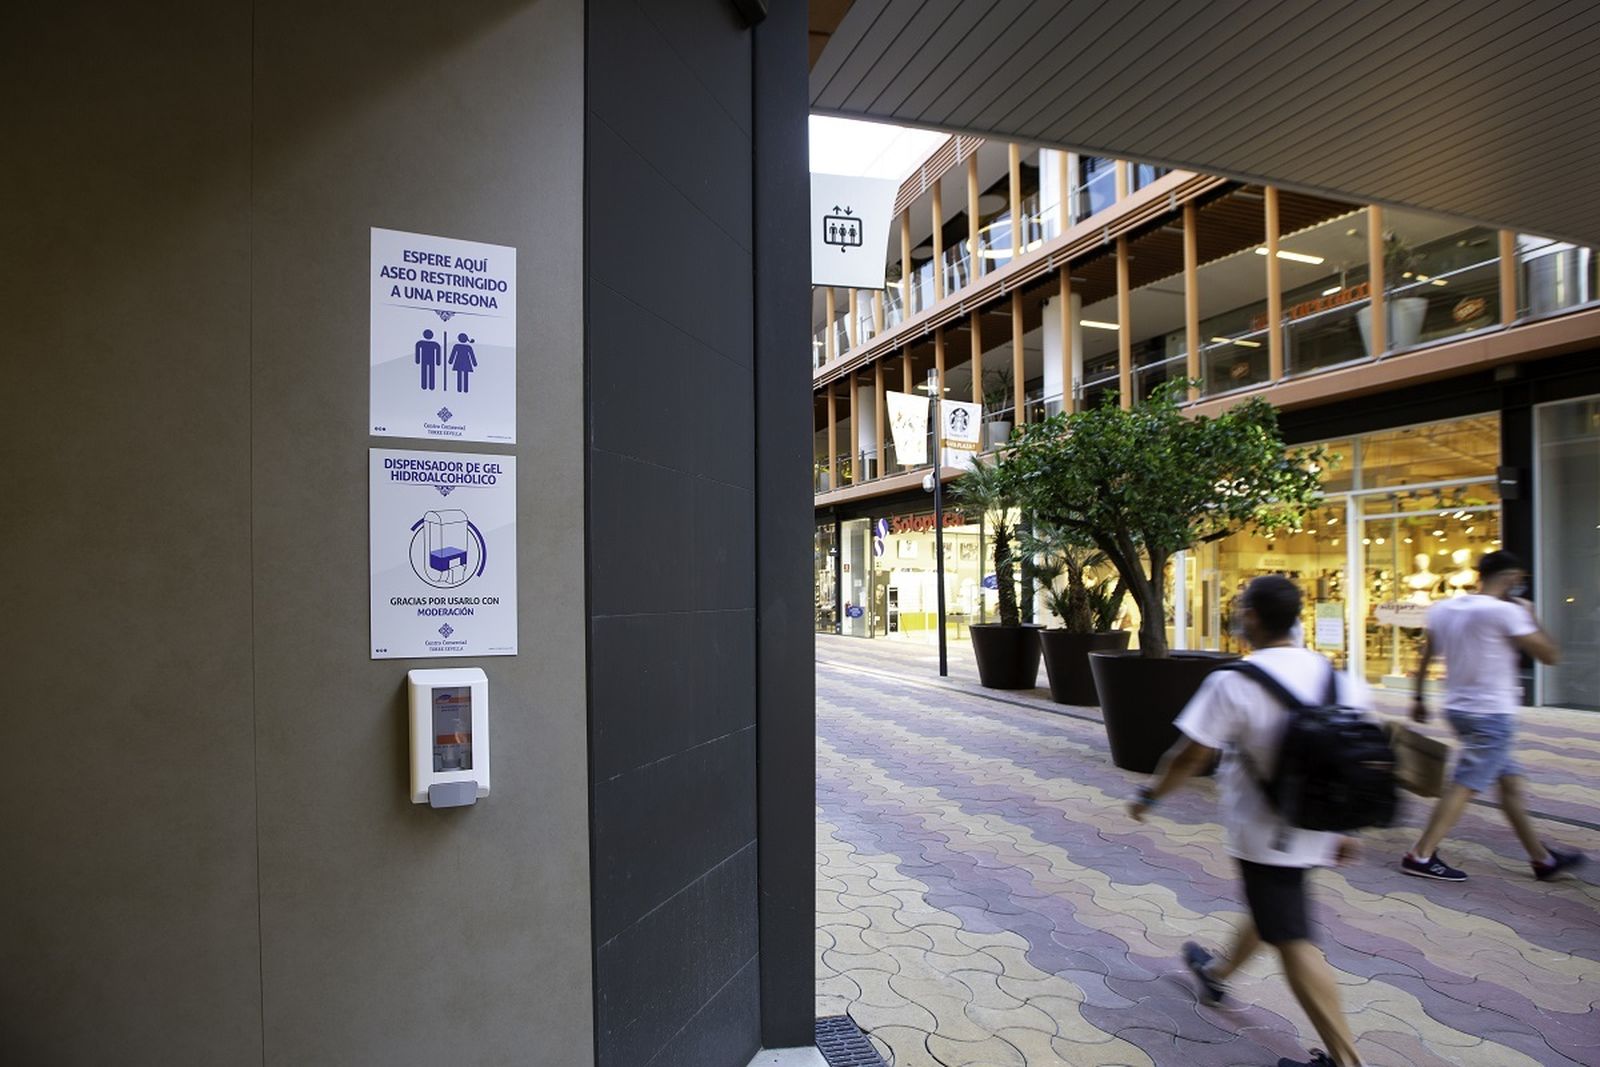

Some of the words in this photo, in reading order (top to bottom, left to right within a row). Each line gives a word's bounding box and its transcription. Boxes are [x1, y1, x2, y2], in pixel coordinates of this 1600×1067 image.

[403, 250, 451, 267] ESPERE
[454, 257, 488, 273] AQUÍ
[380, 265, 417, 281] ASEO
[420, 270, 508, 293] RESTRINGIDO
[390, 285, 401, 298] A
[404, 286, 434, 302] UNA
[436, 290, 498, 309] PERSONA
[384, 458, 464, 472] DISPENSADOR
[466, 462, 481, 473] DE
[483, 463, 503, 475] GEL
[390, 470, 497, 485] HIDROALCOHÓLICO
[390, 597, 427, 606] GRACIAS
[429, 597, 447, 606] POR
[448, 597, 480, 606] USARLO
[481, 597, 500, 605] CON
[417, 607, 474, 616] MODERACIÓN
